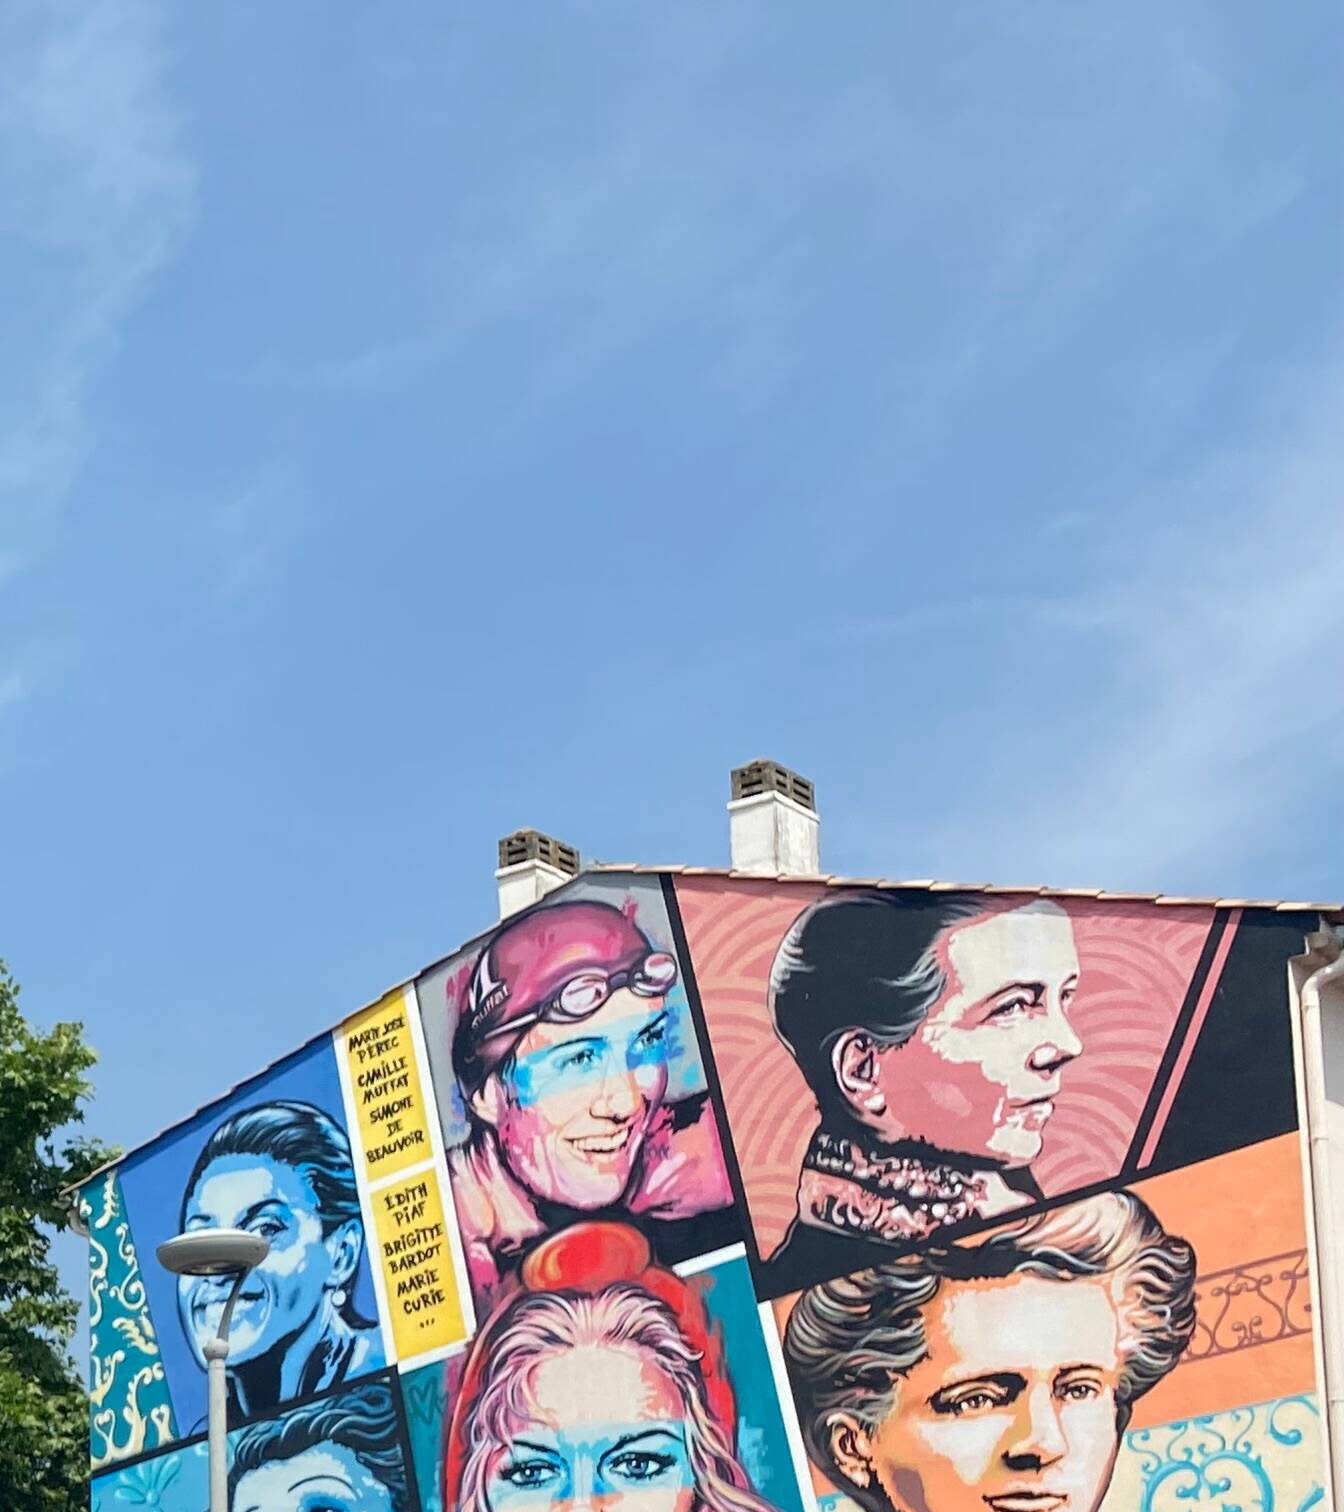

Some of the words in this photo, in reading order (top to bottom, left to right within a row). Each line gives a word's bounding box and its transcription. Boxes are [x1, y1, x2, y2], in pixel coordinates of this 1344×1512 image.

[357, 1056, 409, 1088] CAMILLE
[362, 1073, 410, 1105] MUFFAT
[368, 1094, 414, 1125] SIMONE
[385, 1118, 405, 1138] DE
[365, 1129, 425, 1164] BEAUVOIR
[392, 1200, 427, 1228] PIAF
[382, 1223, 444, 1258] BRIGITTE
[387, 1243, 443, 1275] BARDOT
[396, 1268, 440, 1298] MARIE
[403, 1289, 446, 1316] CURIE
